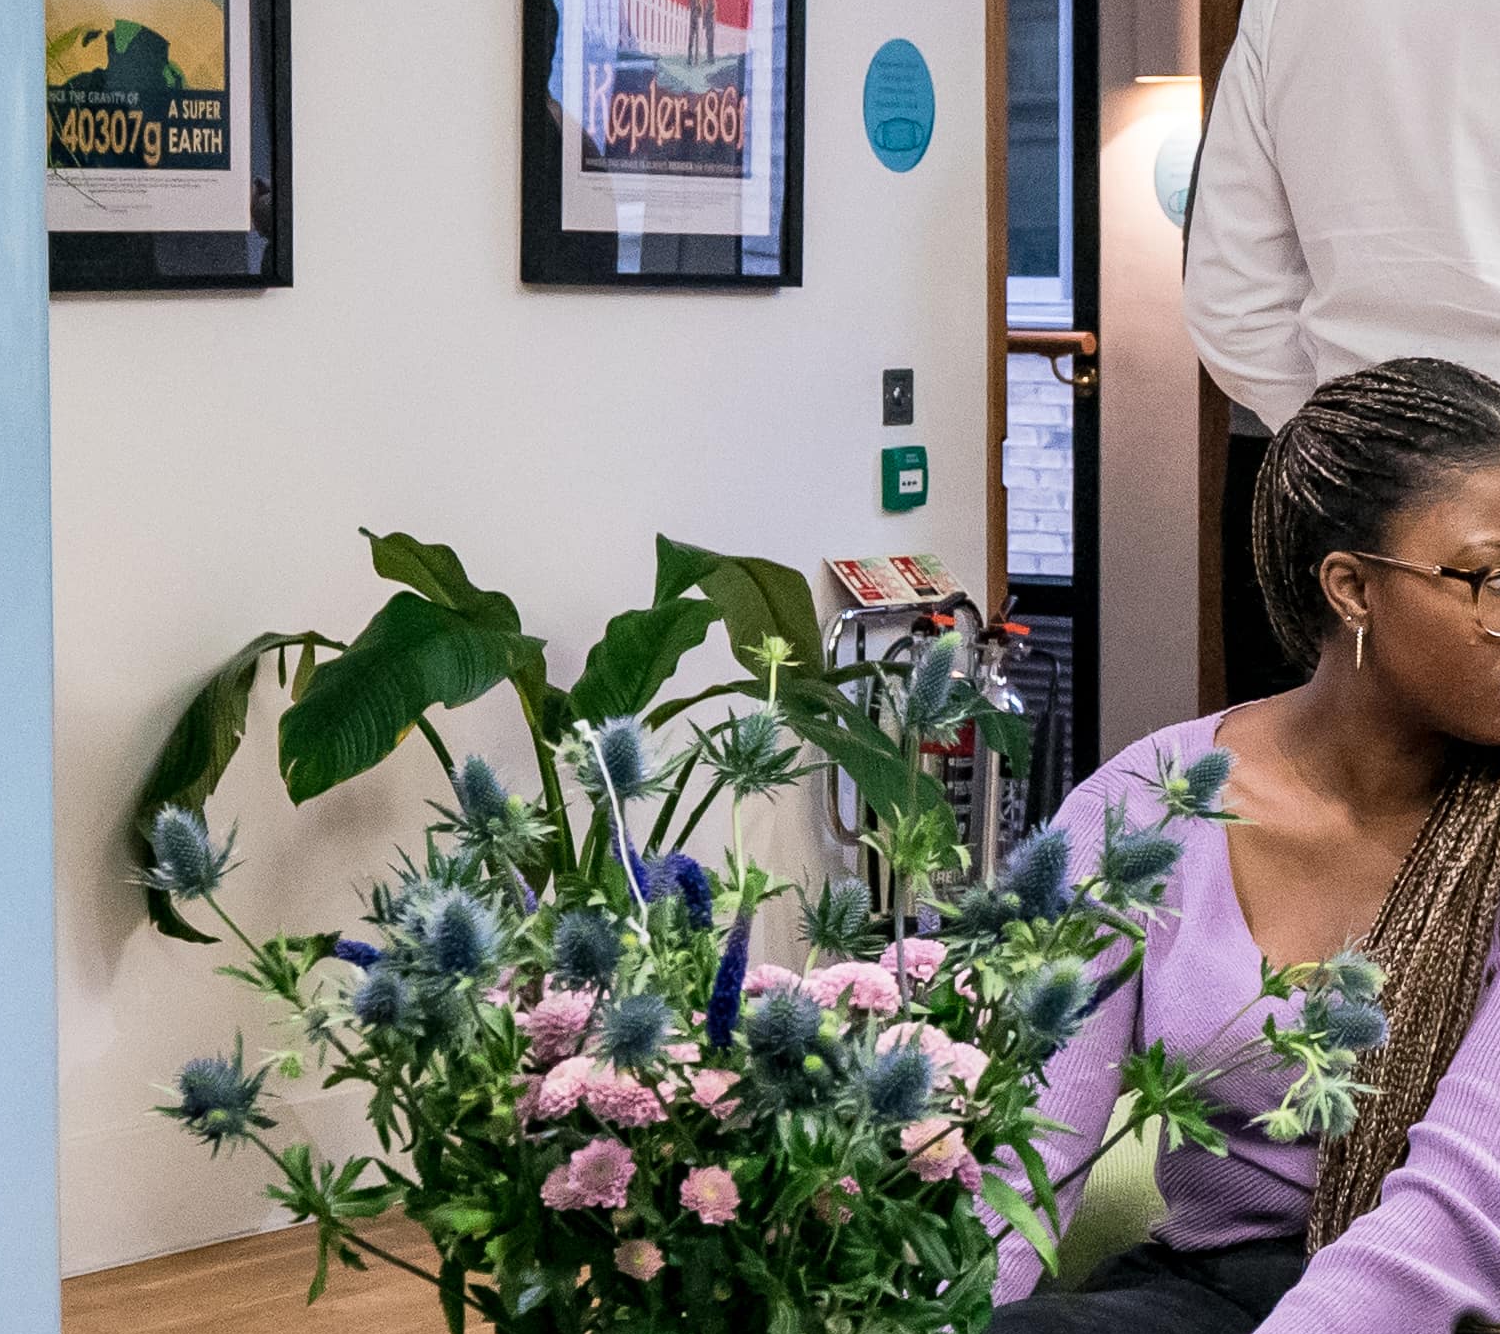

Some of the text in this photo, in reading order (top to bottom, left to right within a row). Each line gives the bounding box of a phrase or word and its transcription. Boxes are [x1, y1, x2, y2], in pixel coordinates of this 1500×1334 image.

[68, 90, 86, 103] THE
[88, 91, 126, 104] GRAVITY
[127, 92, 139, 105] OF
[168, 99, 222, 120] A SUPER
[61, 107, 162, 167] 40307g
[168, 128, 223, 154] EARTH
